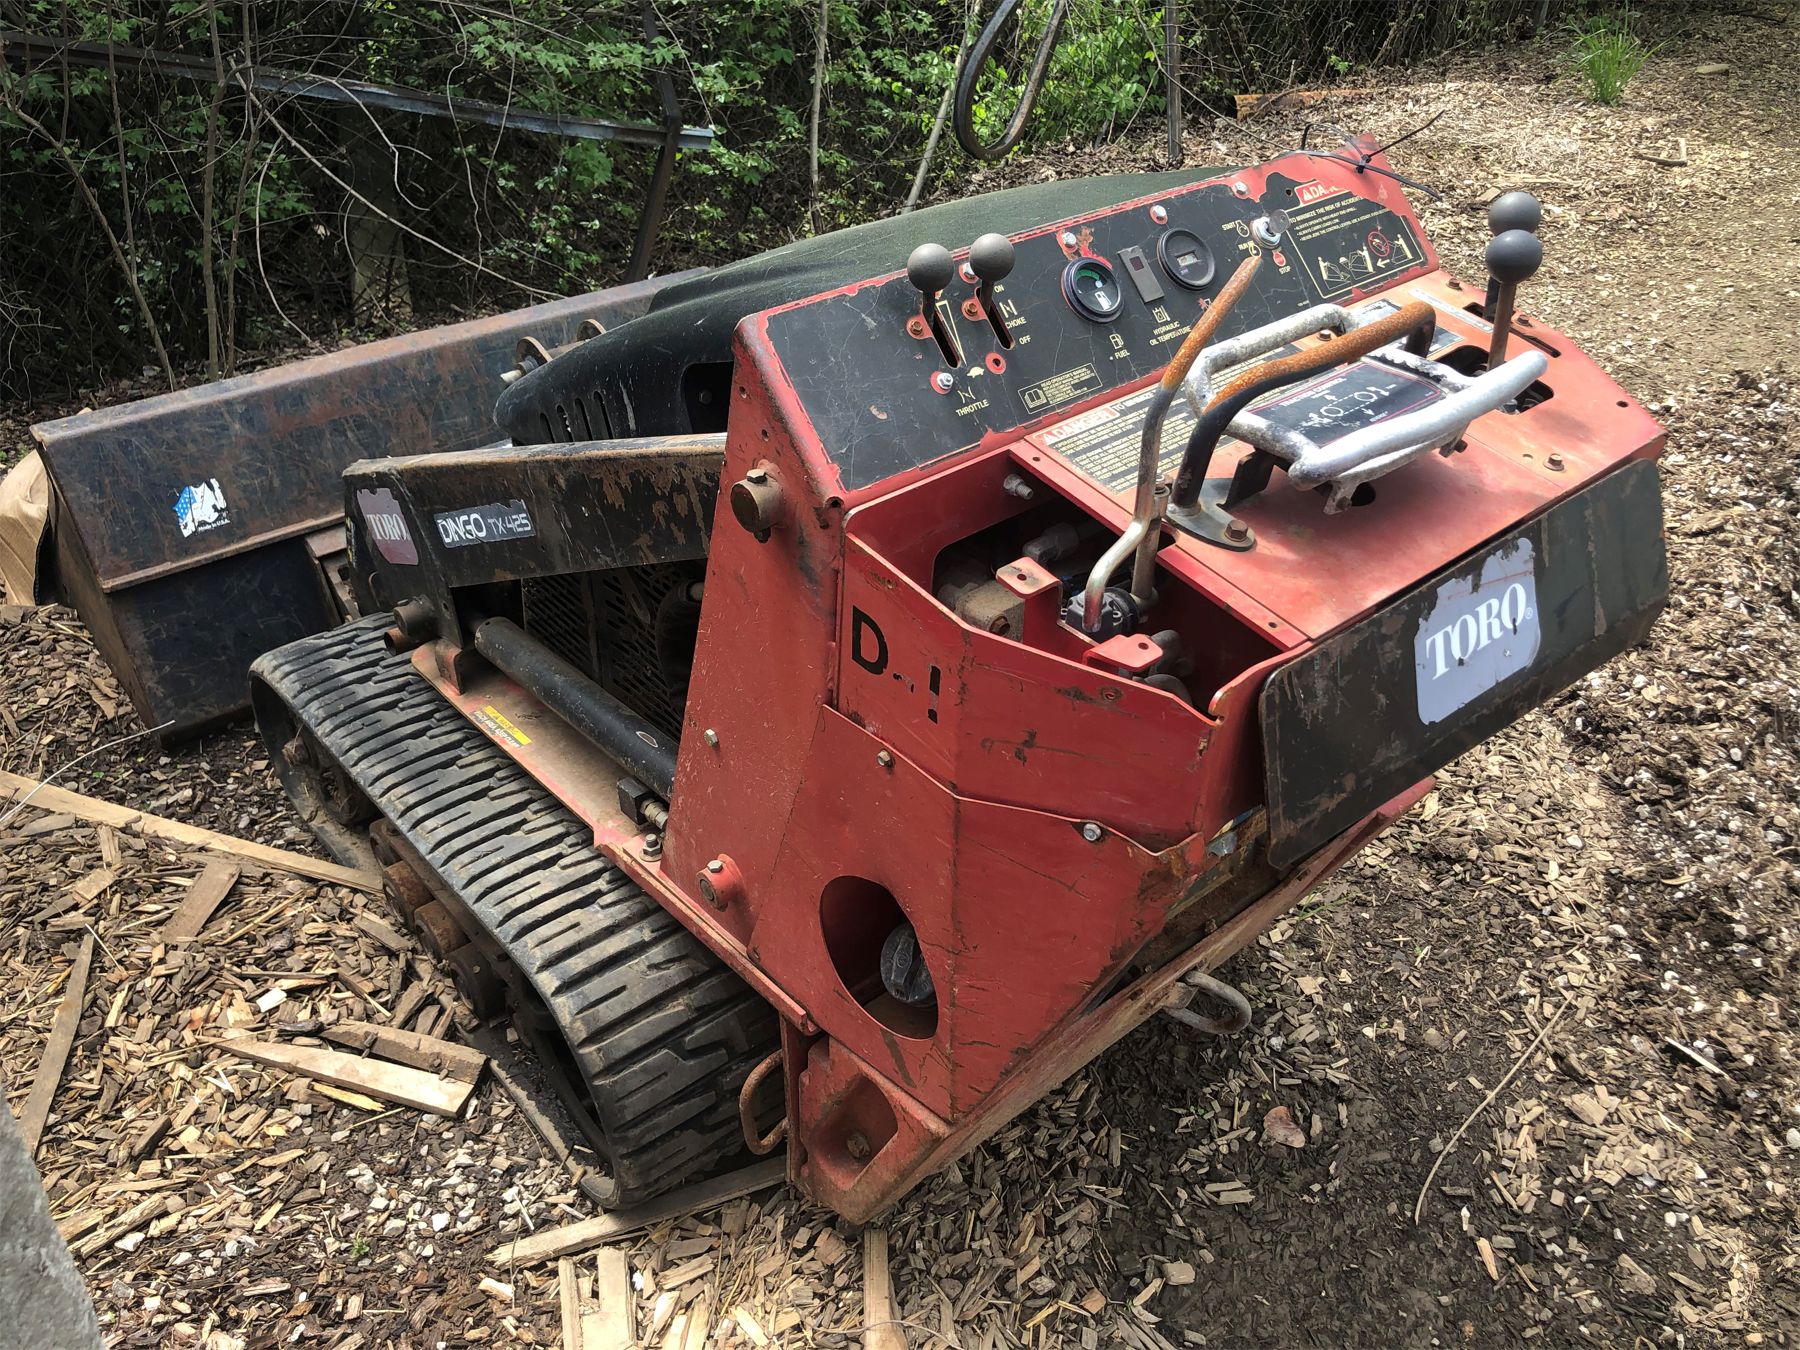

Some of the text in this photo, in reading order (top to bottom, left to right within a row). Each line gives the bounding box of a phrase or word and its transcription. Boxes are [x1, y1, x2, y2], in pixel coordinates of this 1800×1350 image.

[1222, 221, 1236, 230] START
[1279, 265, 1291, 274] STOP
[994, 285, 1005, 293] ON
[1005, 316, 1027, 329] CHOKE
[1153, 321, 1180, 335] HYDRAULIC
[1019, 335, 1031, 345] OFF
[1157, 325, 1192, 343] TEMPERATURE
[1114, 349, 1130, 359] FUEL
[956, 399, 989, 416] THROTTLE
[1051, 408, 1111, 439] DANGER
[1112, 403, 1125, 412] TO
[366, 514, 408, 540] TORO
[437, 513, 487, 543] DINGO
